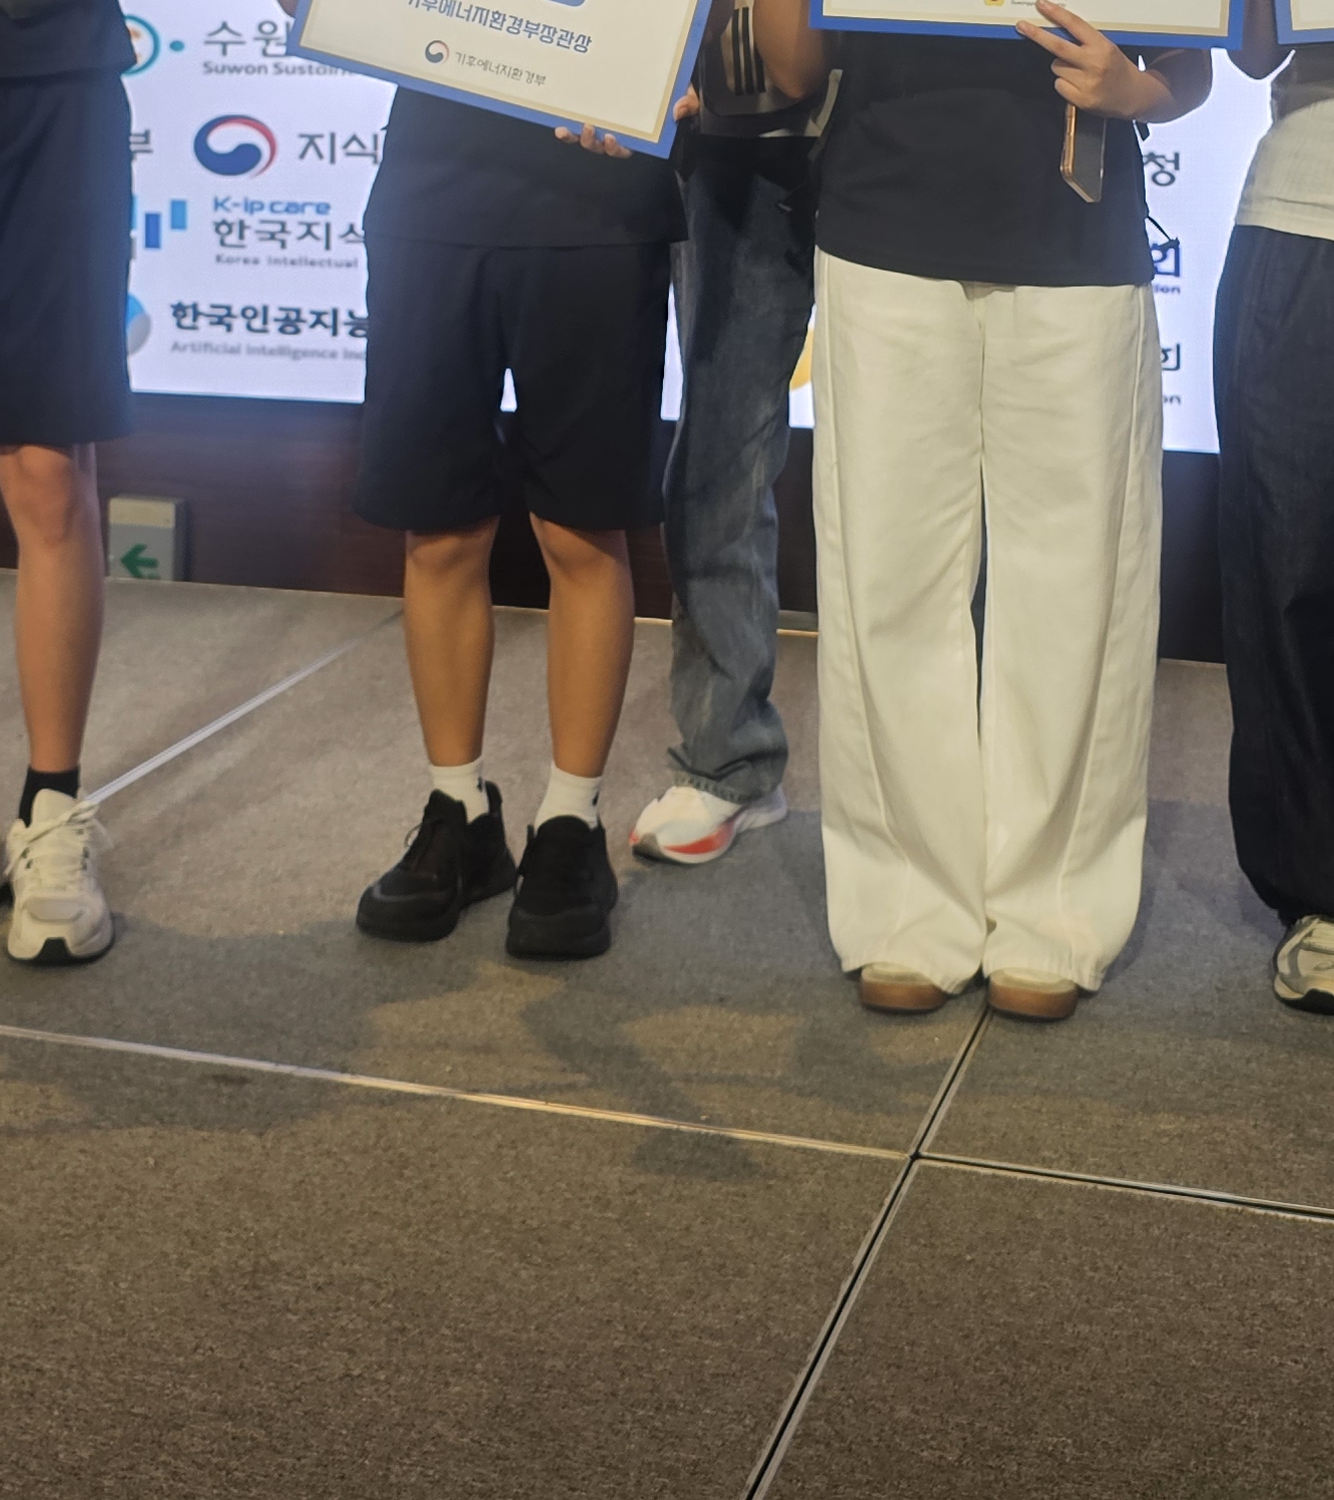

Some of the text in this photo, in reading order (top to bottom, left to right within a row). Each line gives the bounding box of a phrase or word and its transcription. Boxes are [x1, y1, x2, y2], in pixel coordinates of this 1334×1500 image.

[202, 61, 269, 76] Suwon
[455, 51, 547, 86] 기후에너지환경부
[215, 253, 359, 270] Korea Intellectual
[170, 339, 243, 357] Artificial
[246, 340, 339, 361] Intelligence
